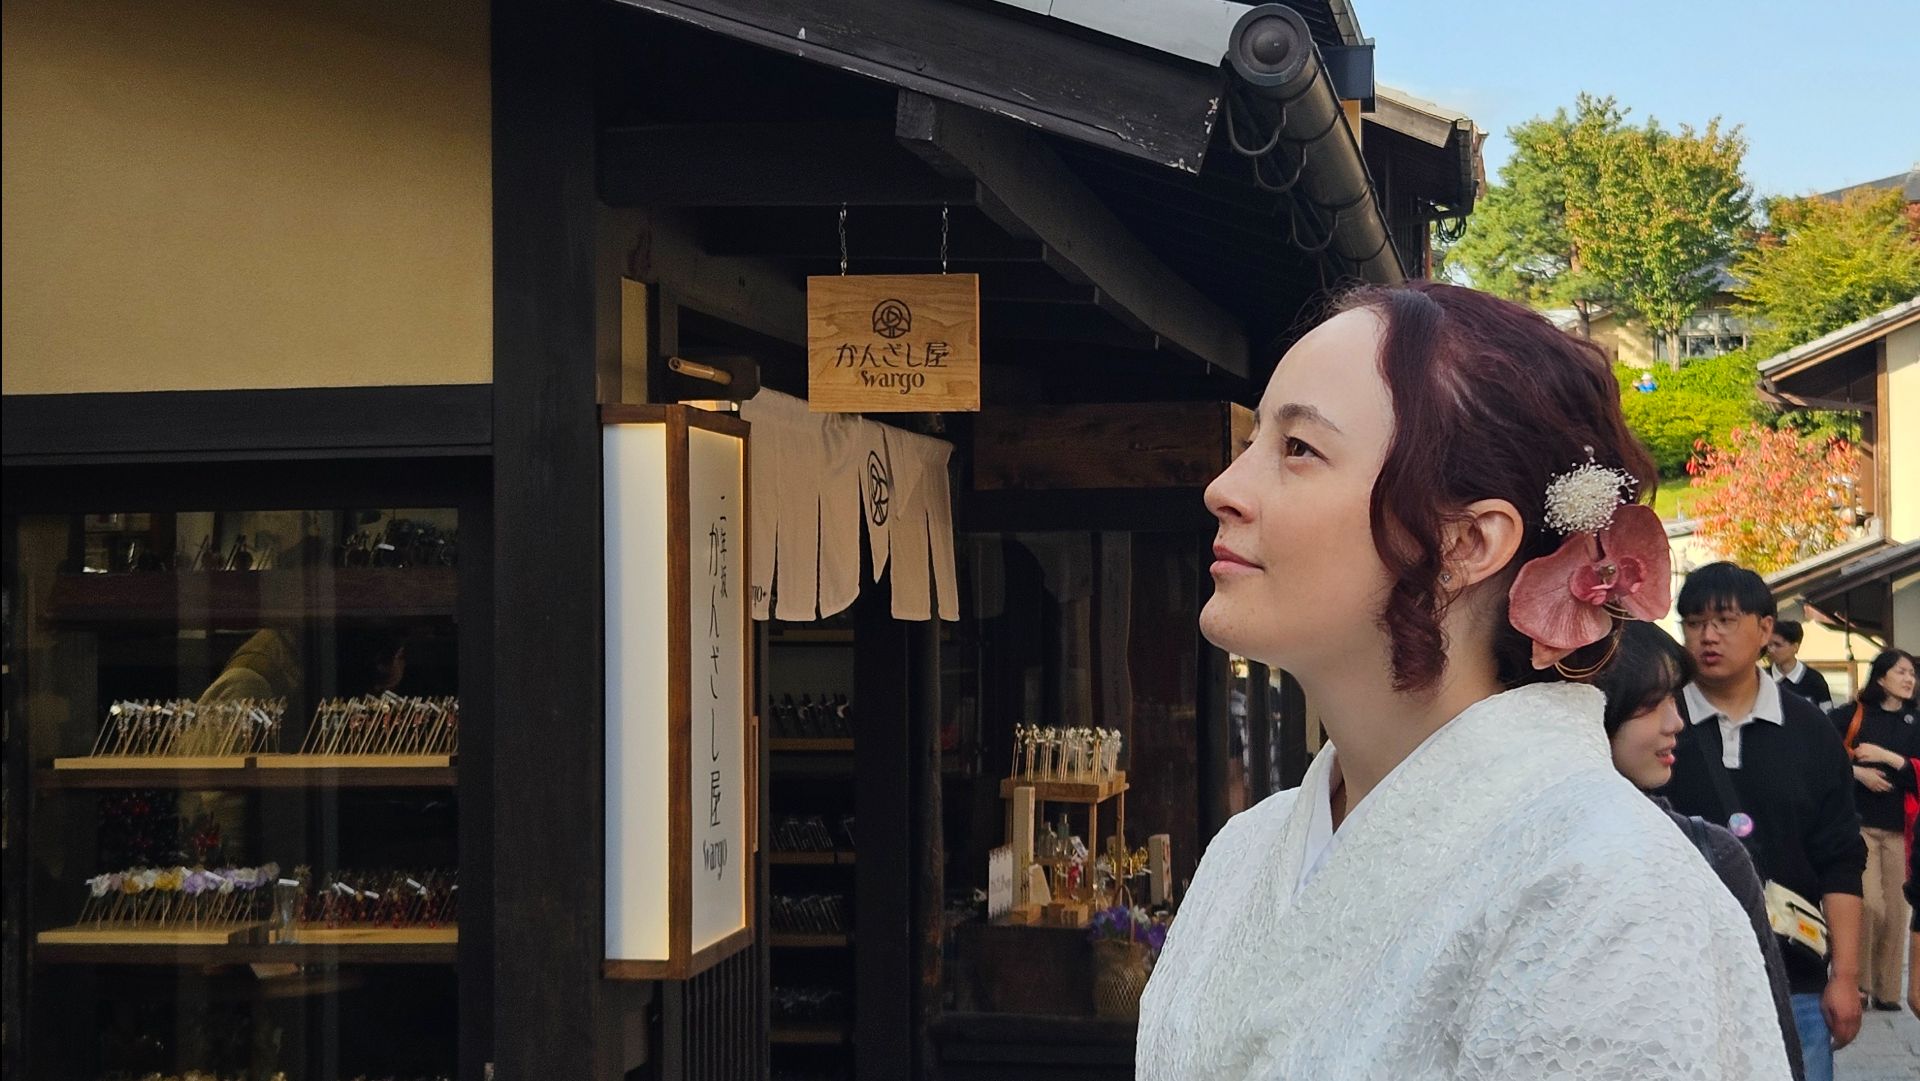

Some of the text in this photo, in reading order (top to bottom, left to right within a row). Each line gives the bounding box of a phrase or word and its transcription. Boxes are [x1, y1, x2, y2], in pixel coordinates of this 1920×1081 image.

[835, 341, 950, 369] かんざし屋
[860, 369, 926, 395] wargo
[708, 521, 721, 828] かんざし屋
[702, 838, 728, 881] wargo
